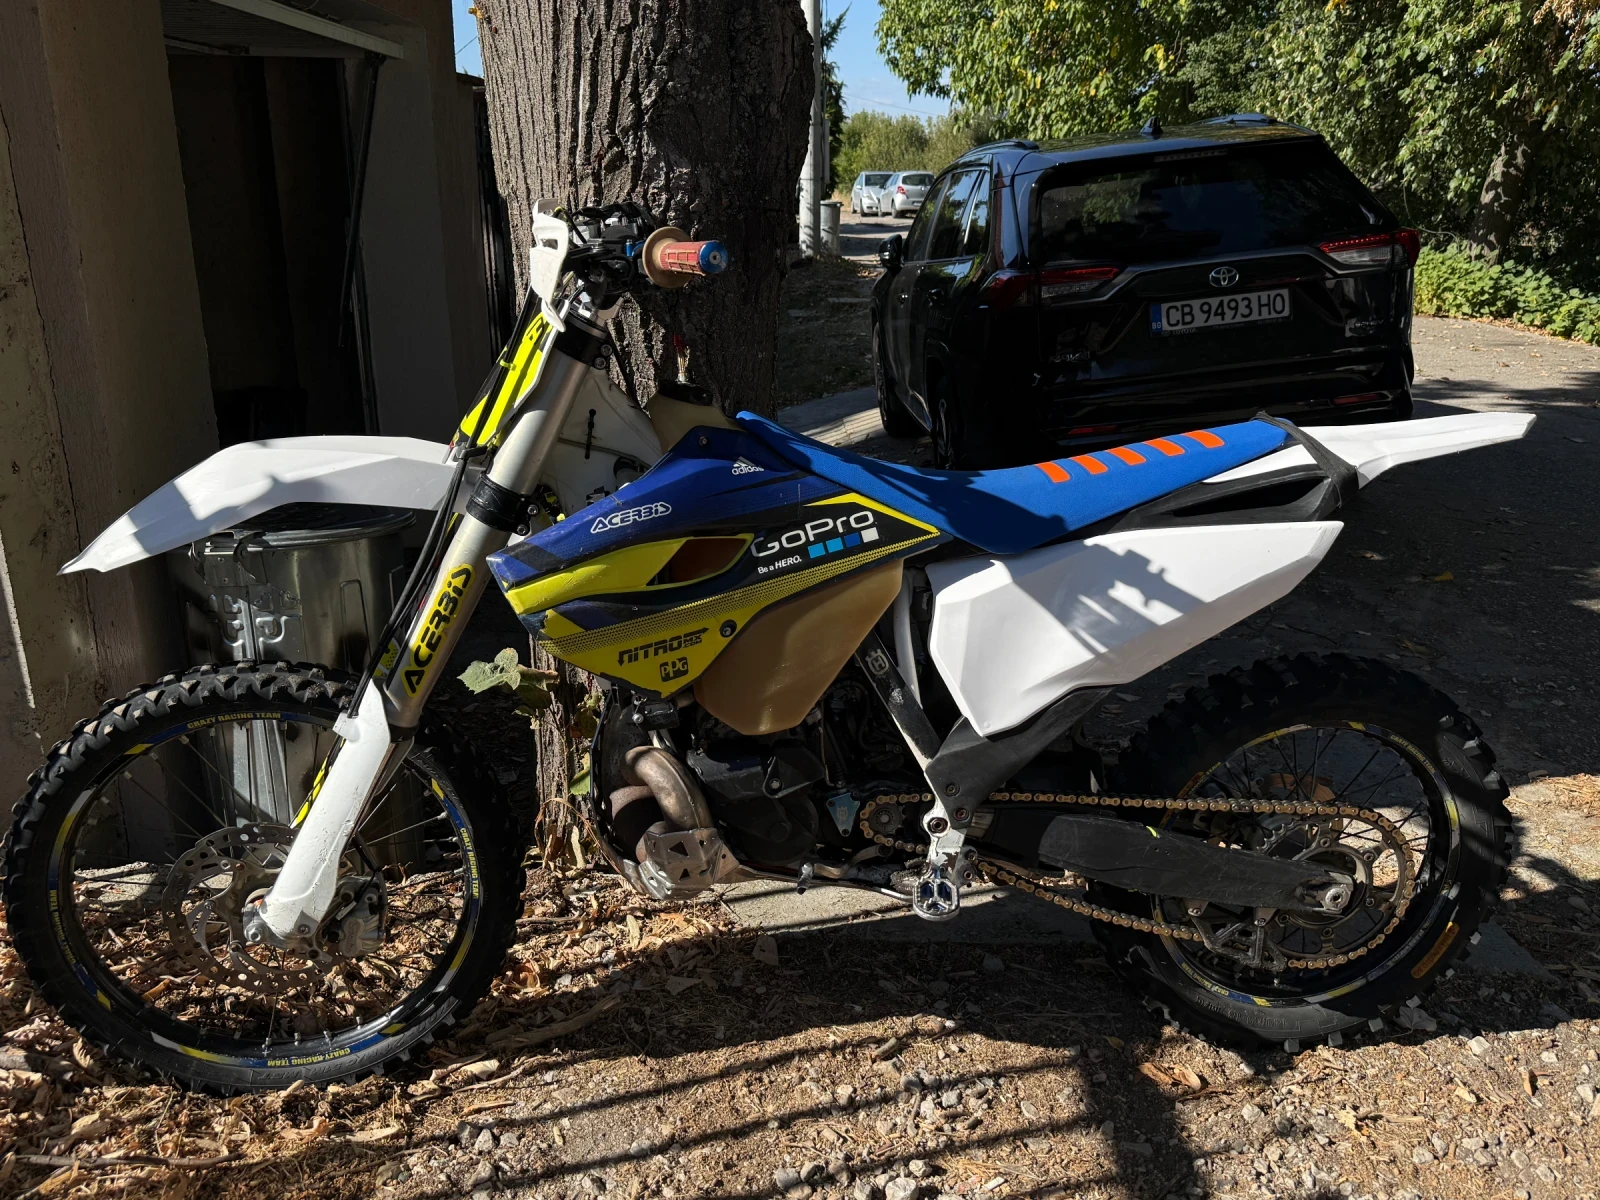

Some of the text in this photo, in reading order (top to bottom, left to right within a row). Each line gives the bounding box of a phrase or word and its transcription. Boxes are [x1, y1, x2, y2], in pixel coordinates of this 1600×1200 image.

[1165, 292, 1286, 328] CB 9493 HO
[1151, 321, 1162, 330] BG
[731, 464, 765, 476] adidas
[590, 501, 672, 534] ACERBIS
[749, 510, 875, 557] GoPro
[757, 565, 769, 574] Be
[404, 566, 472, 695] ACERBIS
[617, 634, 683, 667] NITRO
[660, 658, 688, 678] PPG
[186, 711, 281, 730] CRAZY RACING TEAM
[460, 827, 473, 851] CRAZY
[467, 851, 478, 879] RACING
[49, 889, 59, 911] TEAM
[267, 1048, 351, 1068] CRAZY RACING TEAM
